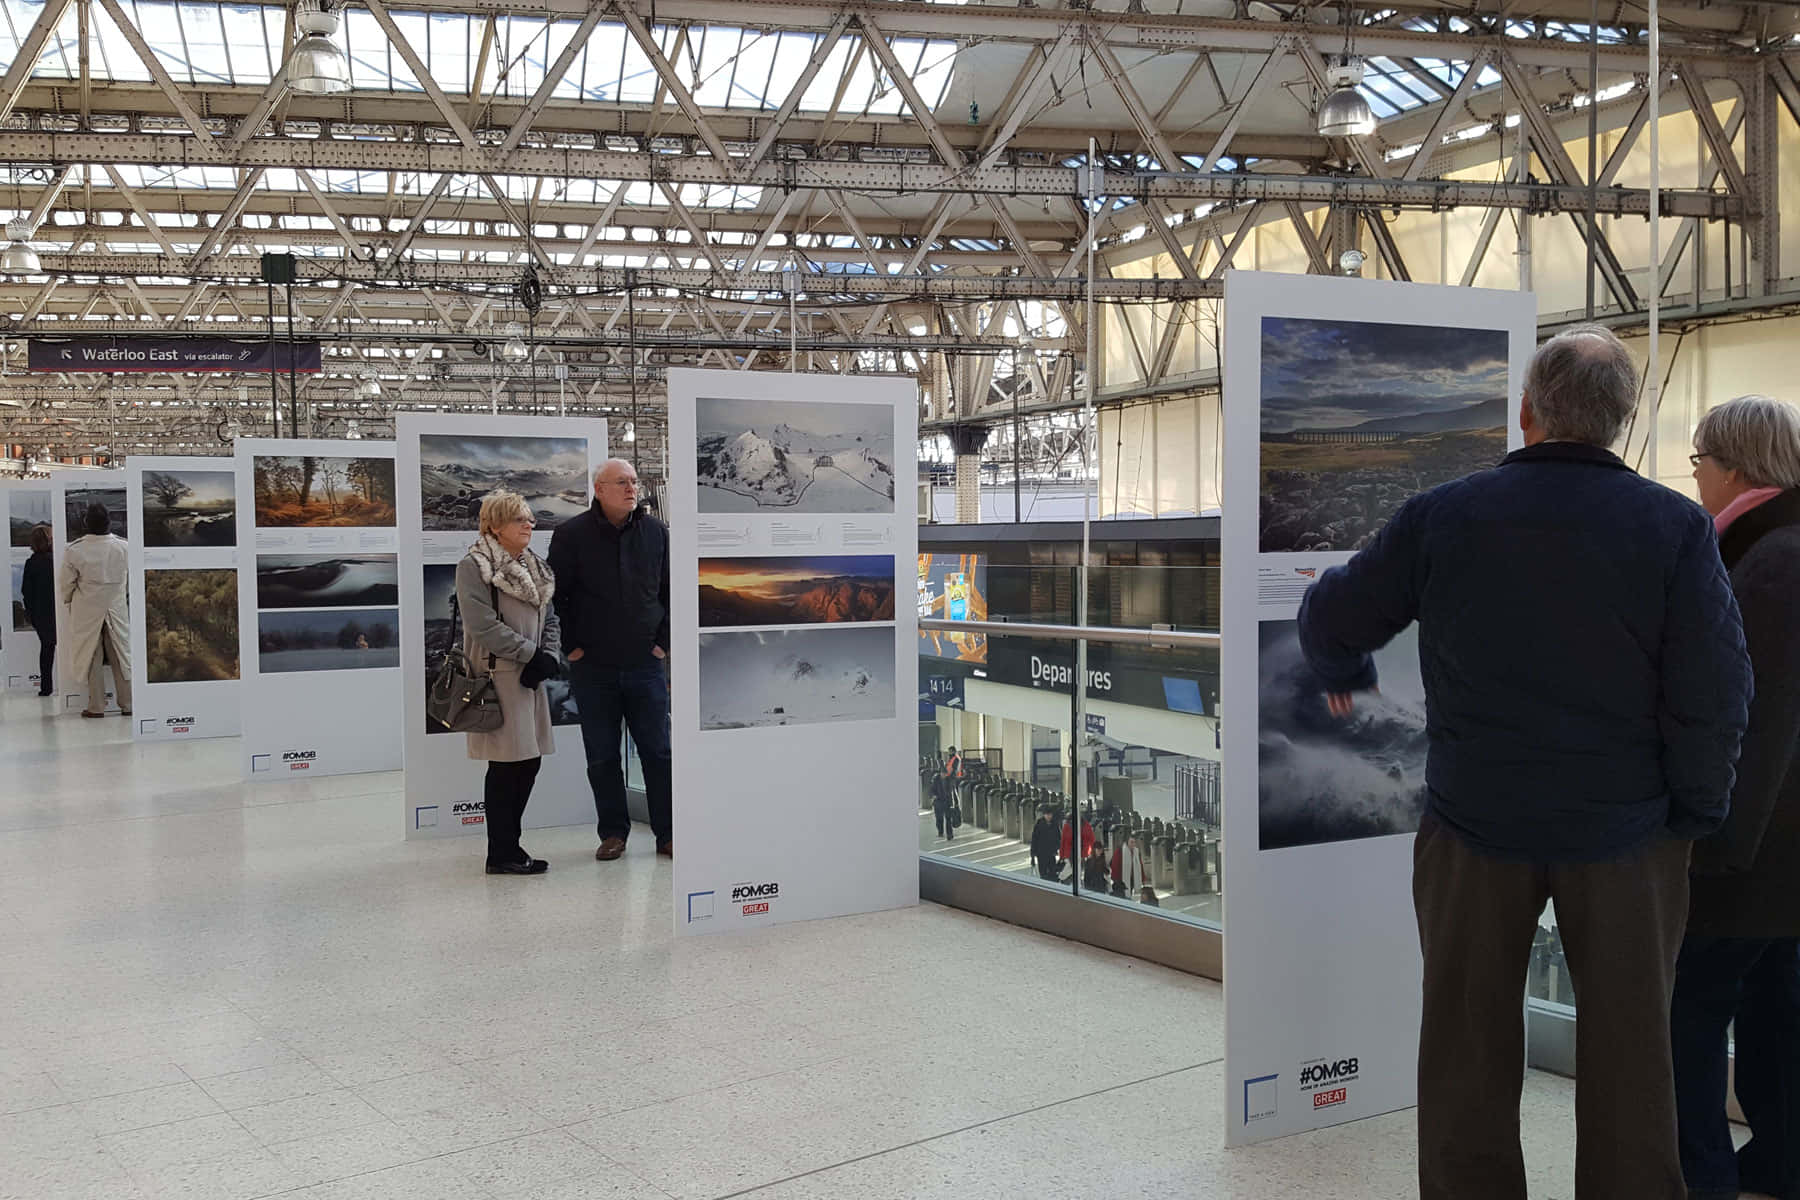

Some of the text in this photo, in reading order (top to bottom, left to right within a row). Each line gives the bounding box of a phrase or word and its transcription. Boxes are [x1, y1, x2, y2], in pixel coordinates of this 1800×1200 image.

[82, 348, 233, 361] Waterloo East via escalator
[1031, 655, 1112, 690] Deparres
[452, 802, 486, 812] #OMG
[731, 883, 779, 899] #OMGB
[743, 903, 768, 913] GREAT
[1299, 1058, 1359, 1085] #OMGB
[1314, 1089, 1345, 1106] GREAT
